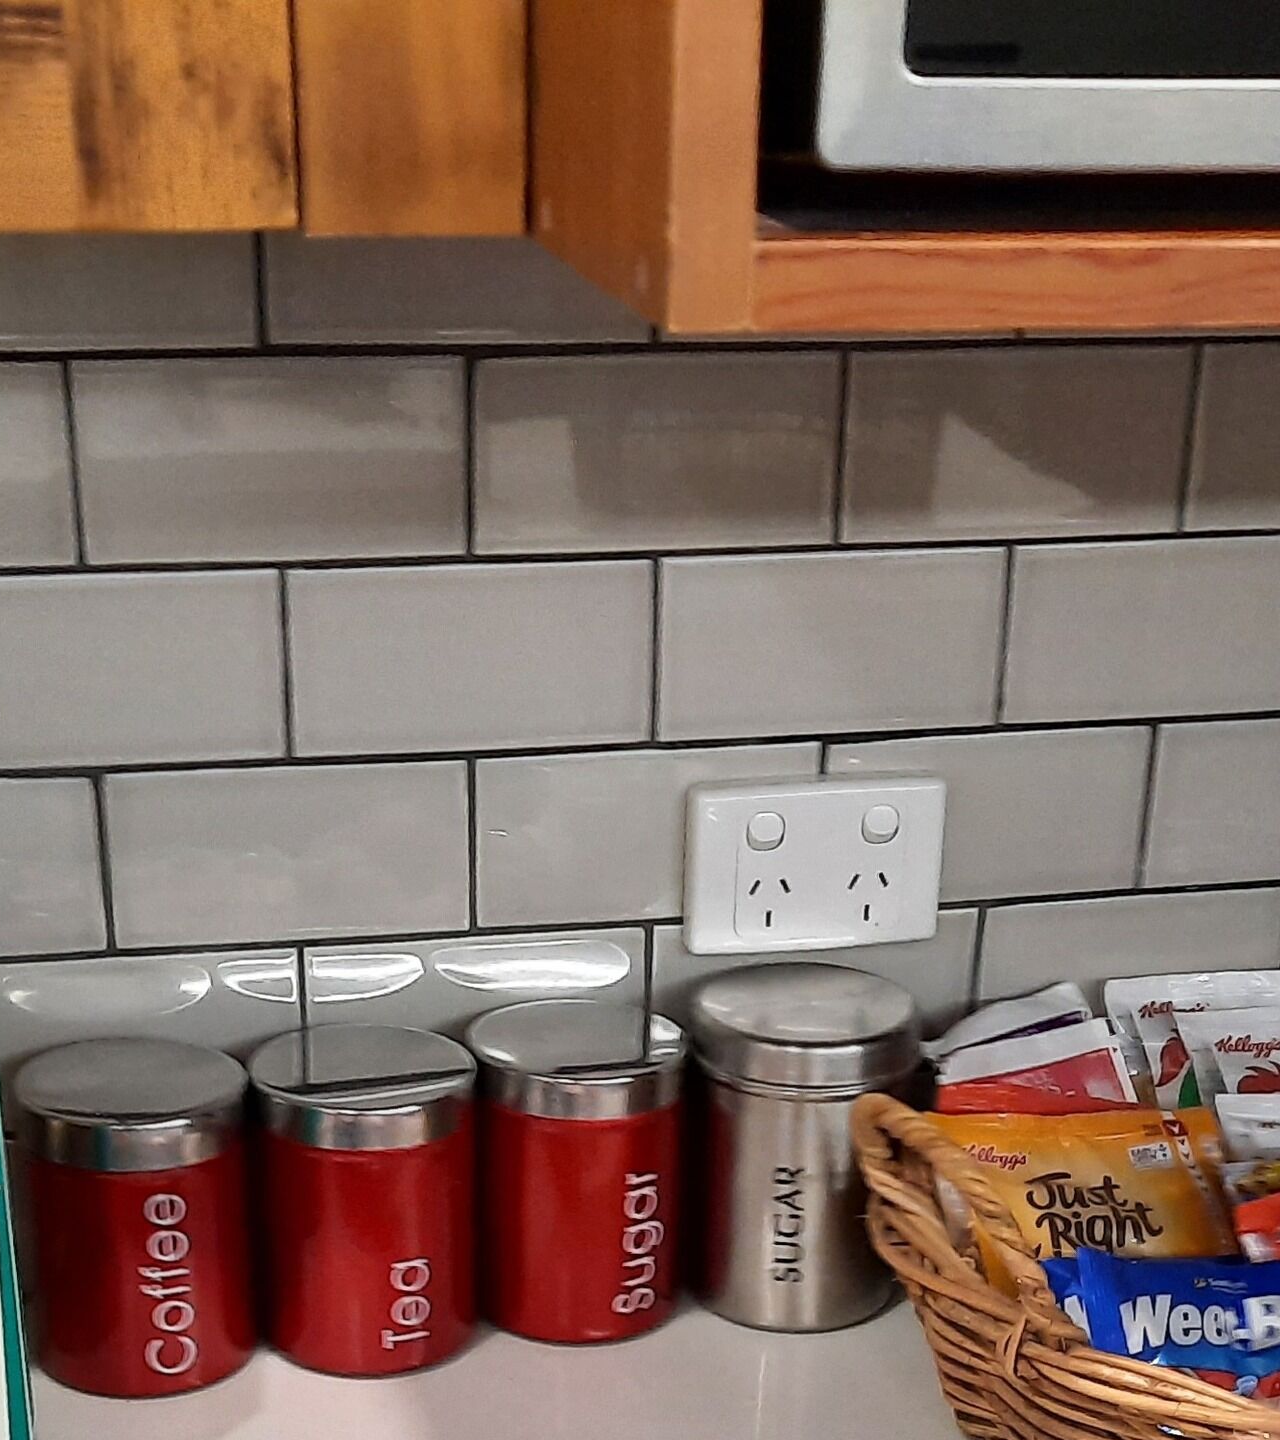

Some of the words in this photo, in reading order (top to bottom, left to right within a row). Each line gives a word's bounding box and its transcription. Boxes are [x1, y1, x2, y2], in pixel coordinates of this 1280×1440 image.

[611, 1173, 664, 1314] Sugar
[774, 1164, 806, 1284] SUGAR
[1024, 1172, 1127, 1210] Just
[1036, 1202, 1163, 1257] Right
[137, 1193, 199, 1374] Coffee
[381, 1257, 431, 1350] Tea
